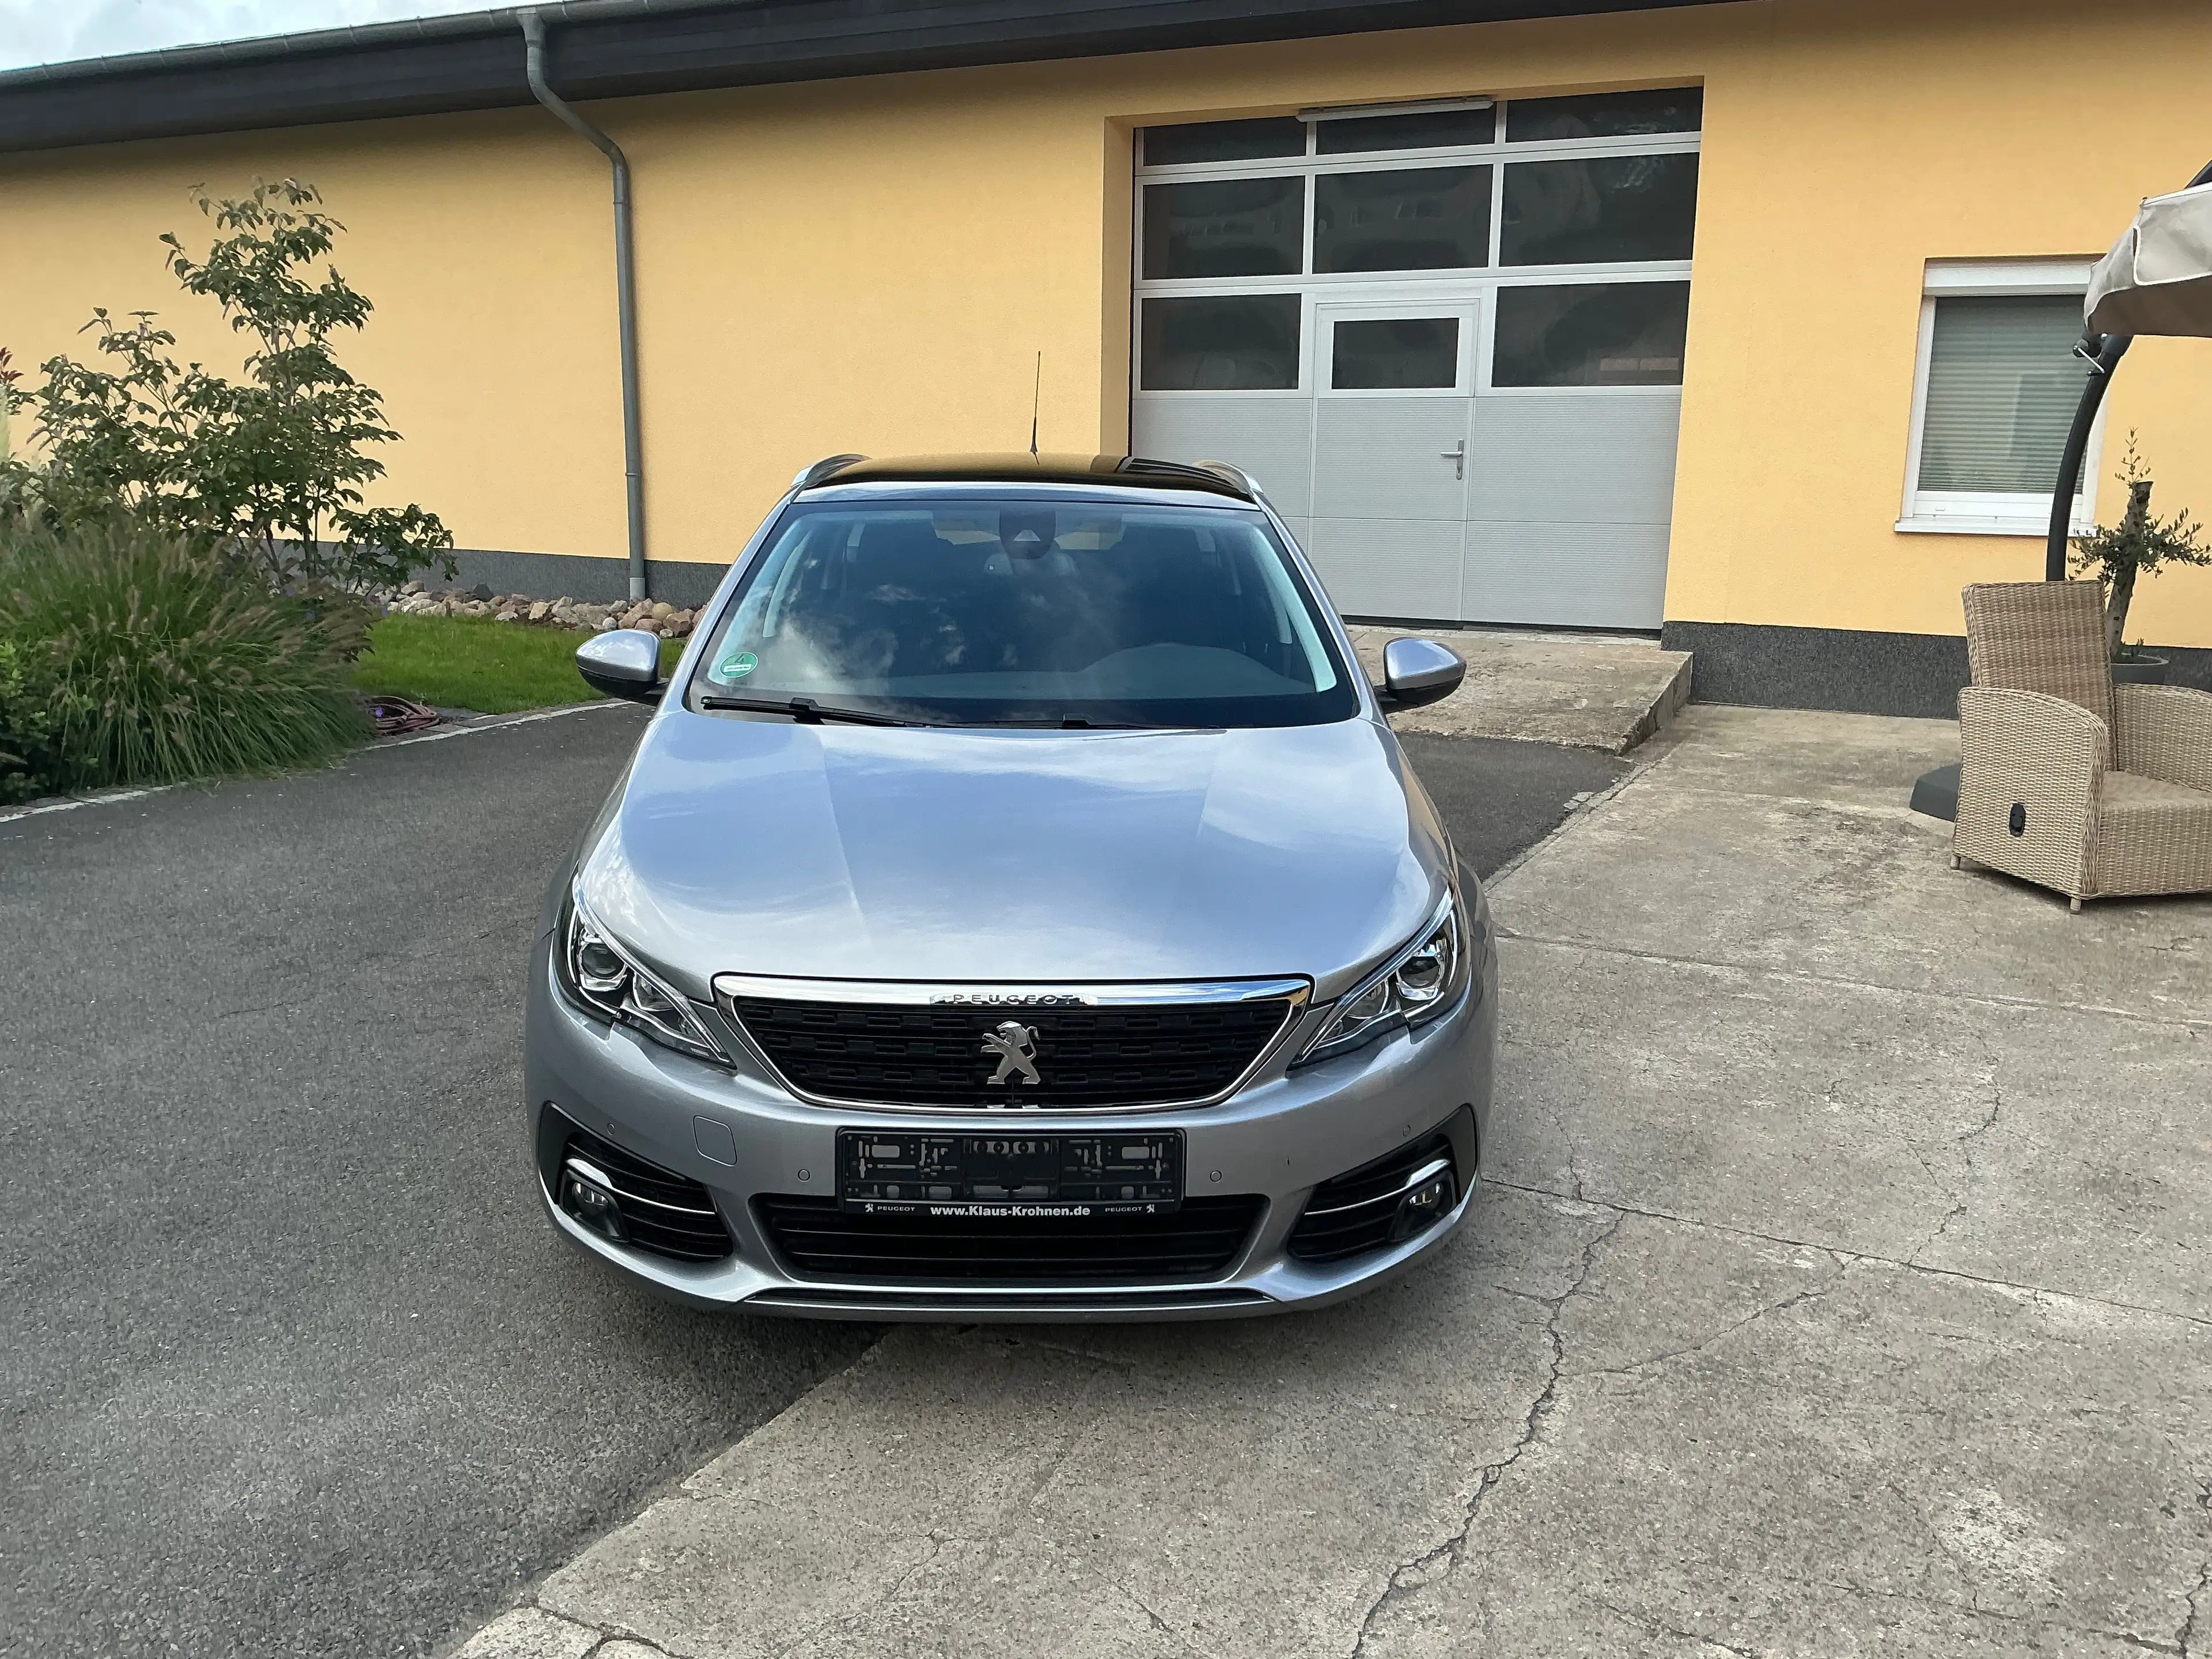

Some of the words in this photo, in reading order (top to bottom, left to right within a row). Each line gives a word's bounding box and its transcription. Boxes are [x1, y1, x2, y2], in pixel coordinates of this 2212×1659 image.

[734, 654, 745, 664] 4
[953, 994, 1074, 1005] PEUGEOT
[930, 1206, 1090, 1216] www.Klaus-Krohnen.de
